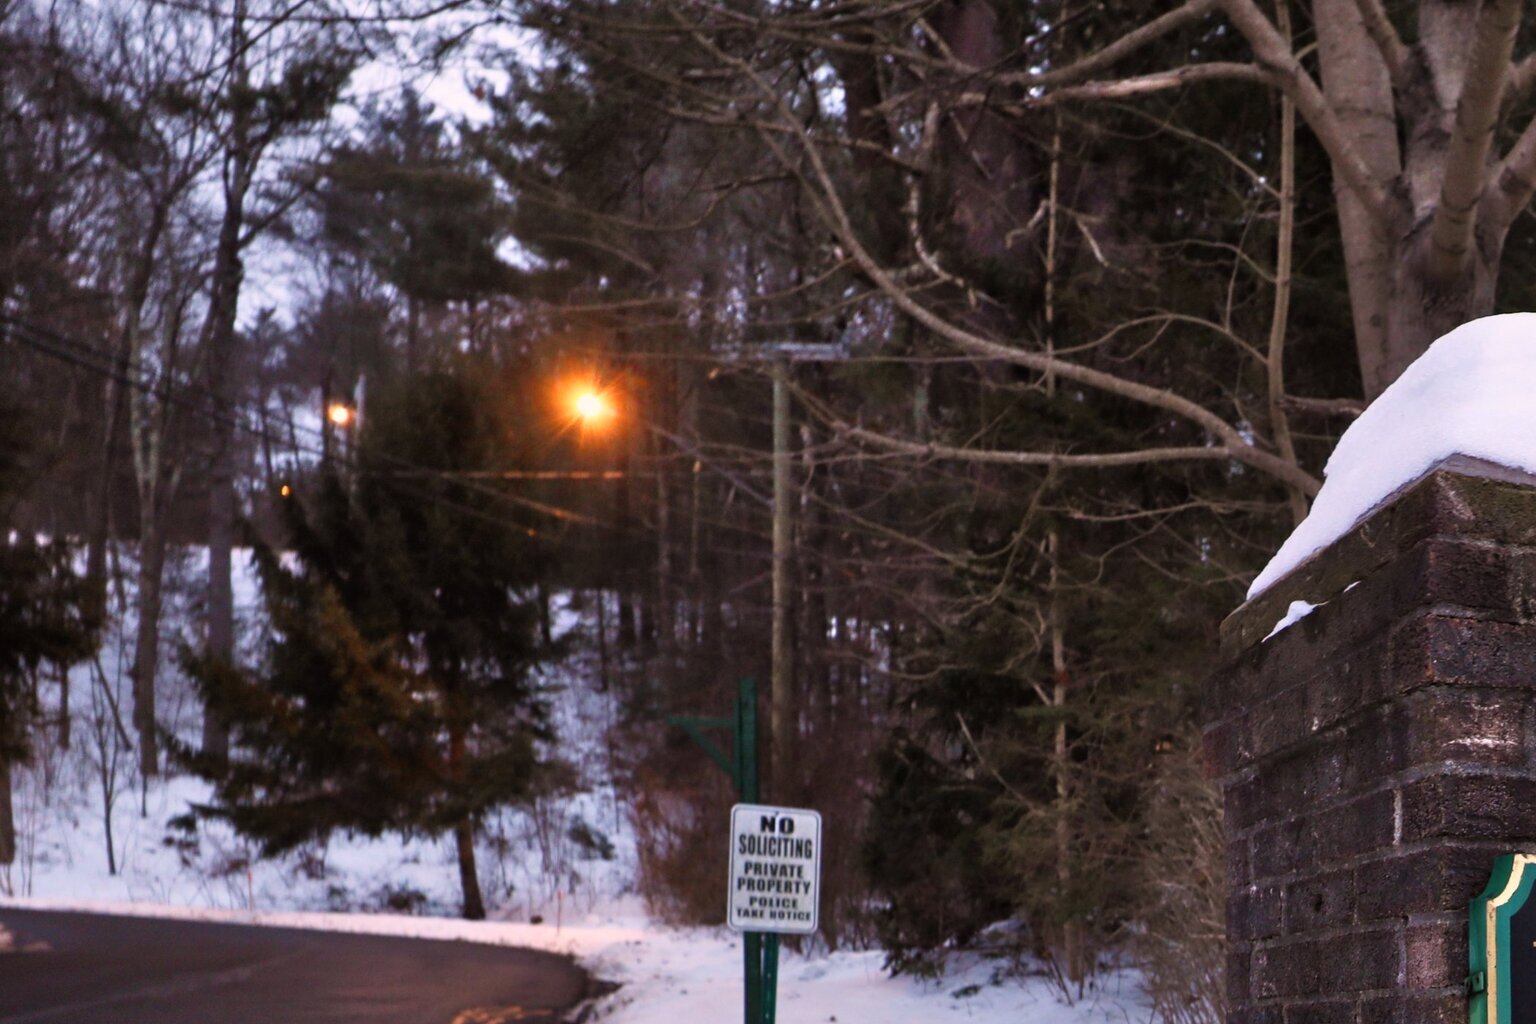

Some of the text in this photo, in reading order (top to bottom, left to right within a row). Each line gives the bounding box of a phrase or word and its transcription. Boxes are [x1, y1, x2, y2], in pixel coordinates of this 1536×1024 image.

[760, 815, 795, 835] NO
[738, 833, 812, 859] SOLICITING
[744, 861, 804, 879] PRIVATE
[737, 877, 811, 895] PROPERTY
[749, 895, 799, 909] POLICE
[736, 908, 811, 921] TAKE NOTICE
